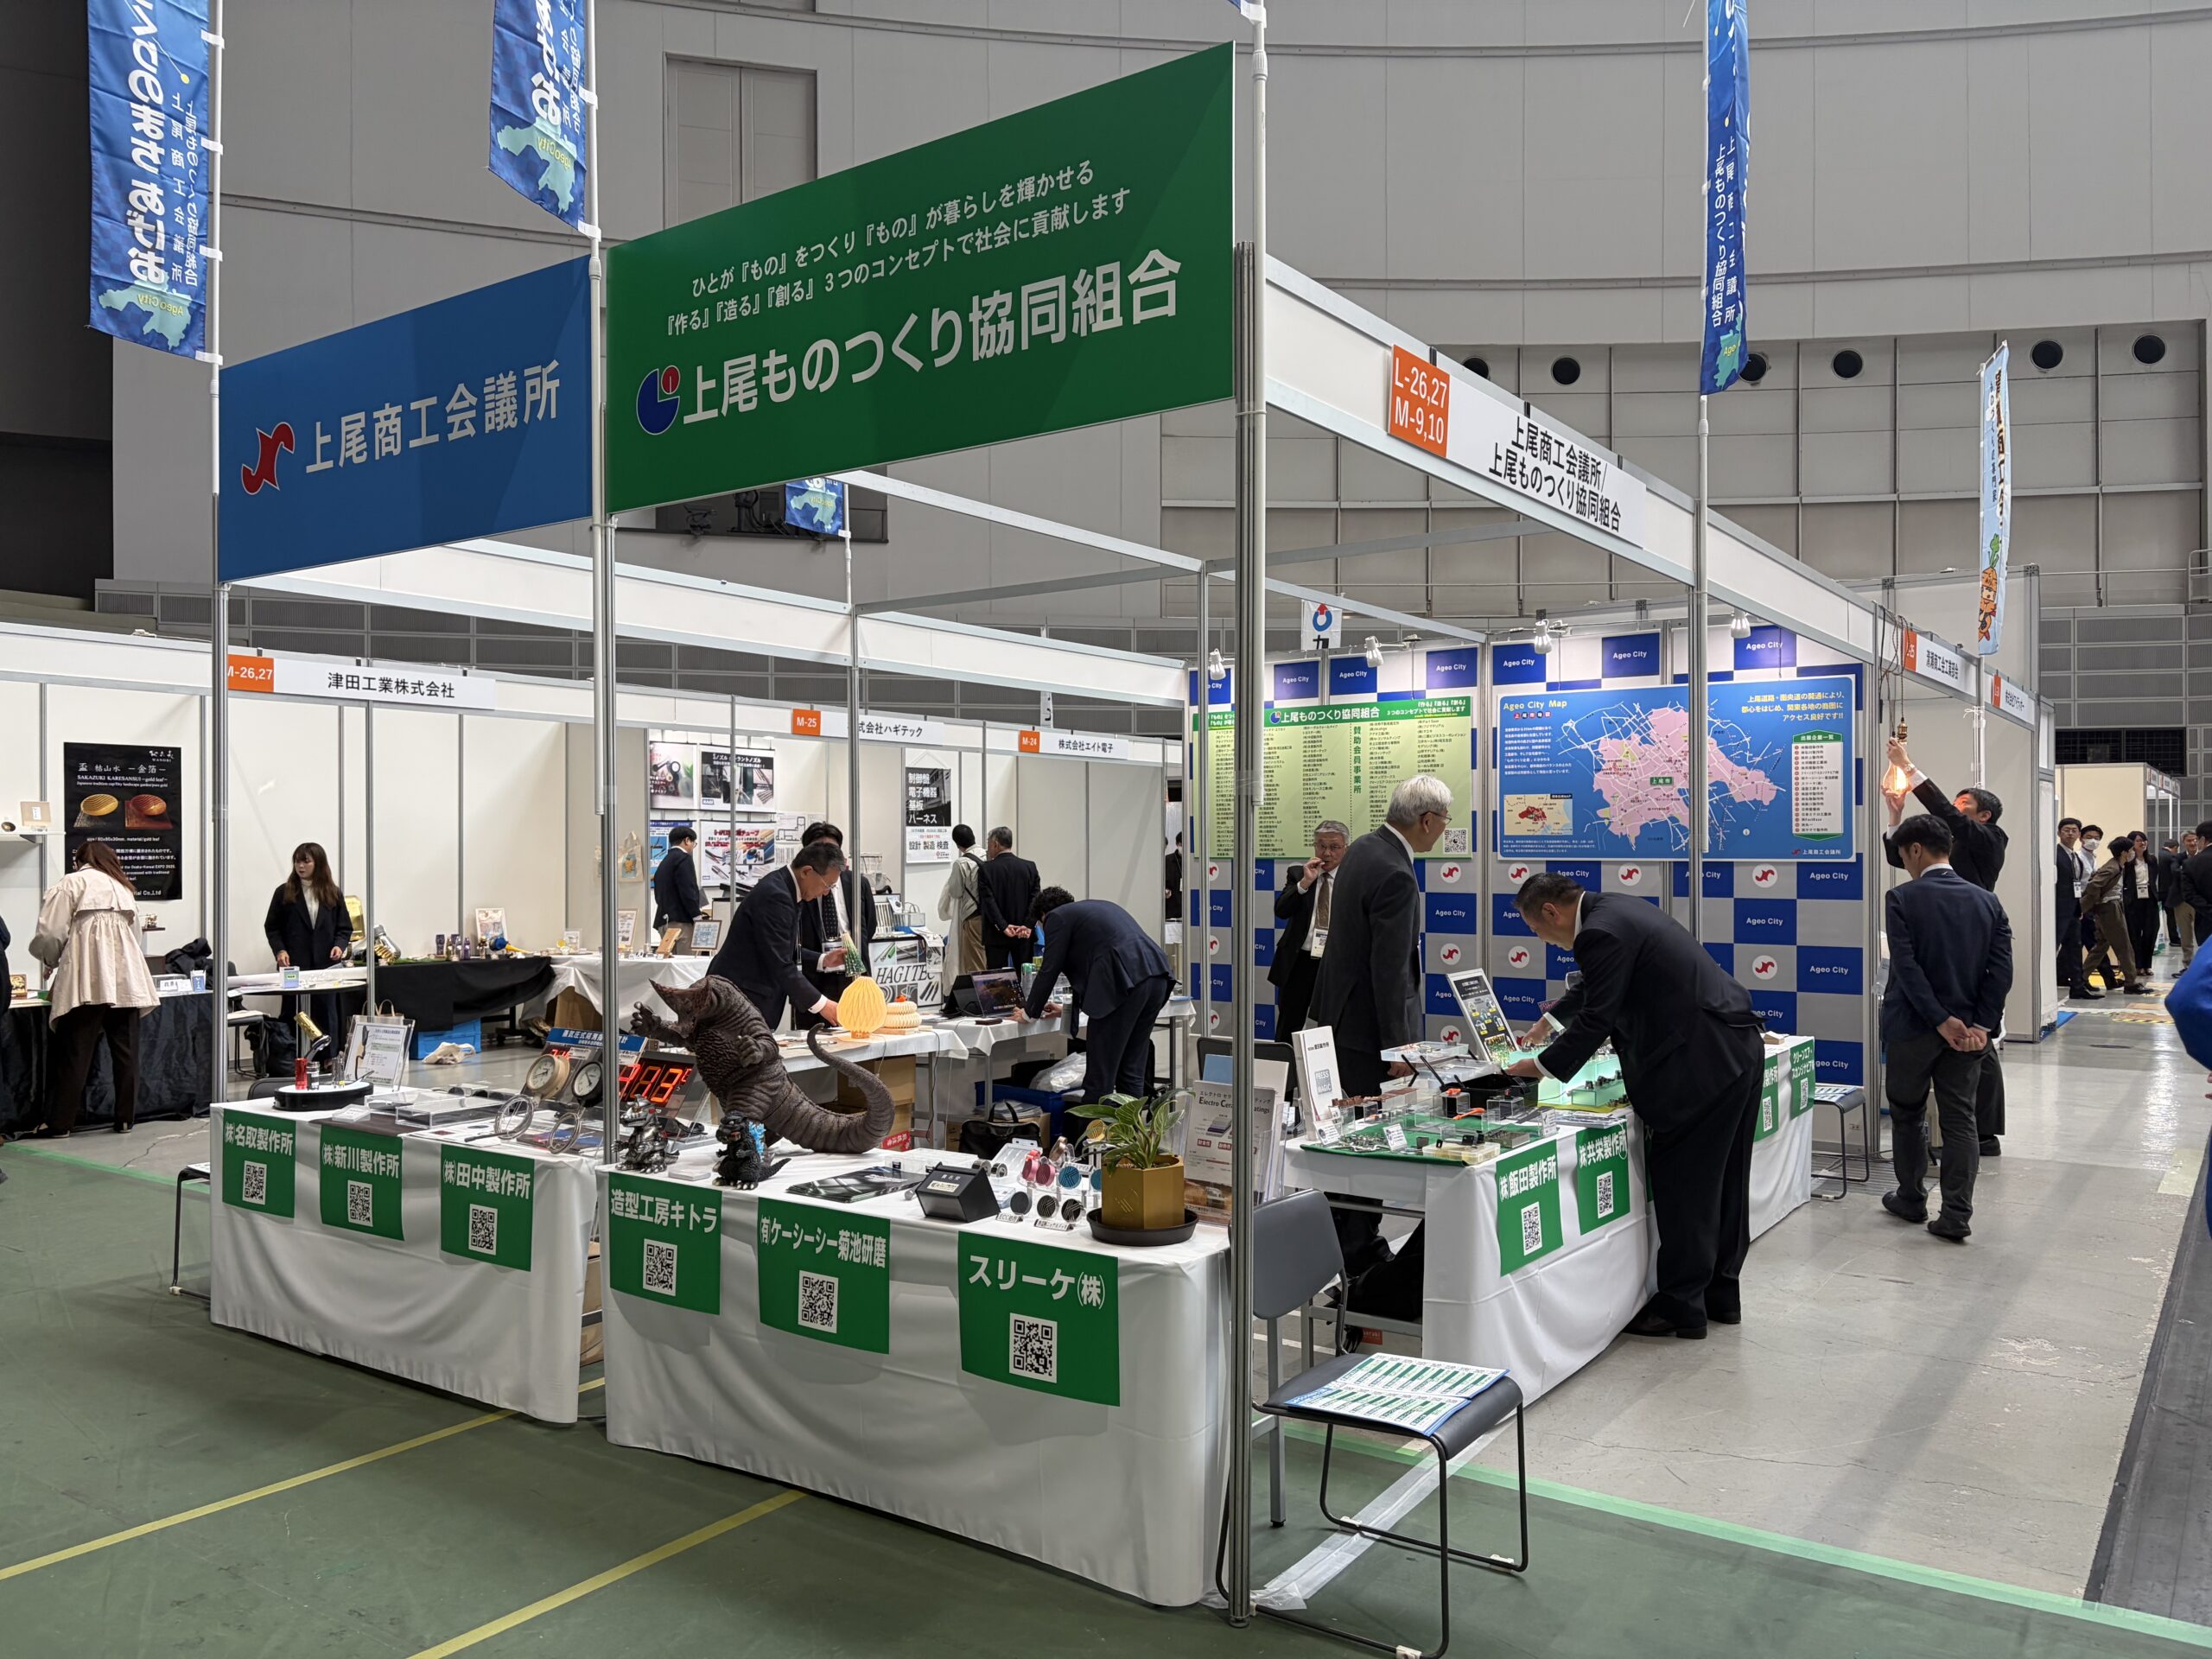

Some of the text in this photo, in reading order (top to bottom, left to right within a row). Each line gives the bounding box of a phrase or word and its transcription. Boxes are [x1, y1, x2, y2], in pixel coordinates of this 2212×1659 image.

[1711, 143, 1727, 328] 上尾ものつくり協同組合
[683, 247, 1182, 425] 上尾ものつくり協同組合
[1395, 356, 1447, 409] L-26,27
[305, 358, 562, 474] 上尾商工会議所
[1395, 396, 1445, 445] M-9,10
[1489, 442, 1622, 533] 上尾ものつくり協同組合
[327, 671, 455, 698] 津田工業株式会社
[796, 716, 817, 729] M-25
[1281, 706, 1380, 723] 上尾ものつくり協同組合
[1503, 699, 1567, 711] Ageo City Map
[856, 721, 924, 738] 式会社ハギテック
[1022, 736, 1037, 747] M-24
[1058, 739, 1114, 753] 株式会社エイト電子
[908, 772, 931, 785] 制御盤
[1353, 726, 1362, 794] 賛助会員事業所
[908, 786, 938, 798] 電子機器
[909, 800, 924, 811] 基板
[908, 814, 938, 823] ハーネス
[909, 842, 921, 850] 設計
[937, 841, 949, 850] 検査
[1198, 1096, 1219, 1107] Electro
[223, 1121, 293, 1157] (株)名取製作所
[1579, 1128, 1627, 1170] (株)共栄製作所
[321, 1142, 400, 1180] (株)新川製作所
[442, 1159, 531, 1200] (株)田中製作所
[1499, 1154, 1556, 1203] (株)飯田製作所
[610, 1187, 718, 1234] 造型工房キトラ
[759, 1214, 887, 1268] (有)ケーシーシー菊池研磨
[967, 1255, 1106, 1311] スリーケ(株)
